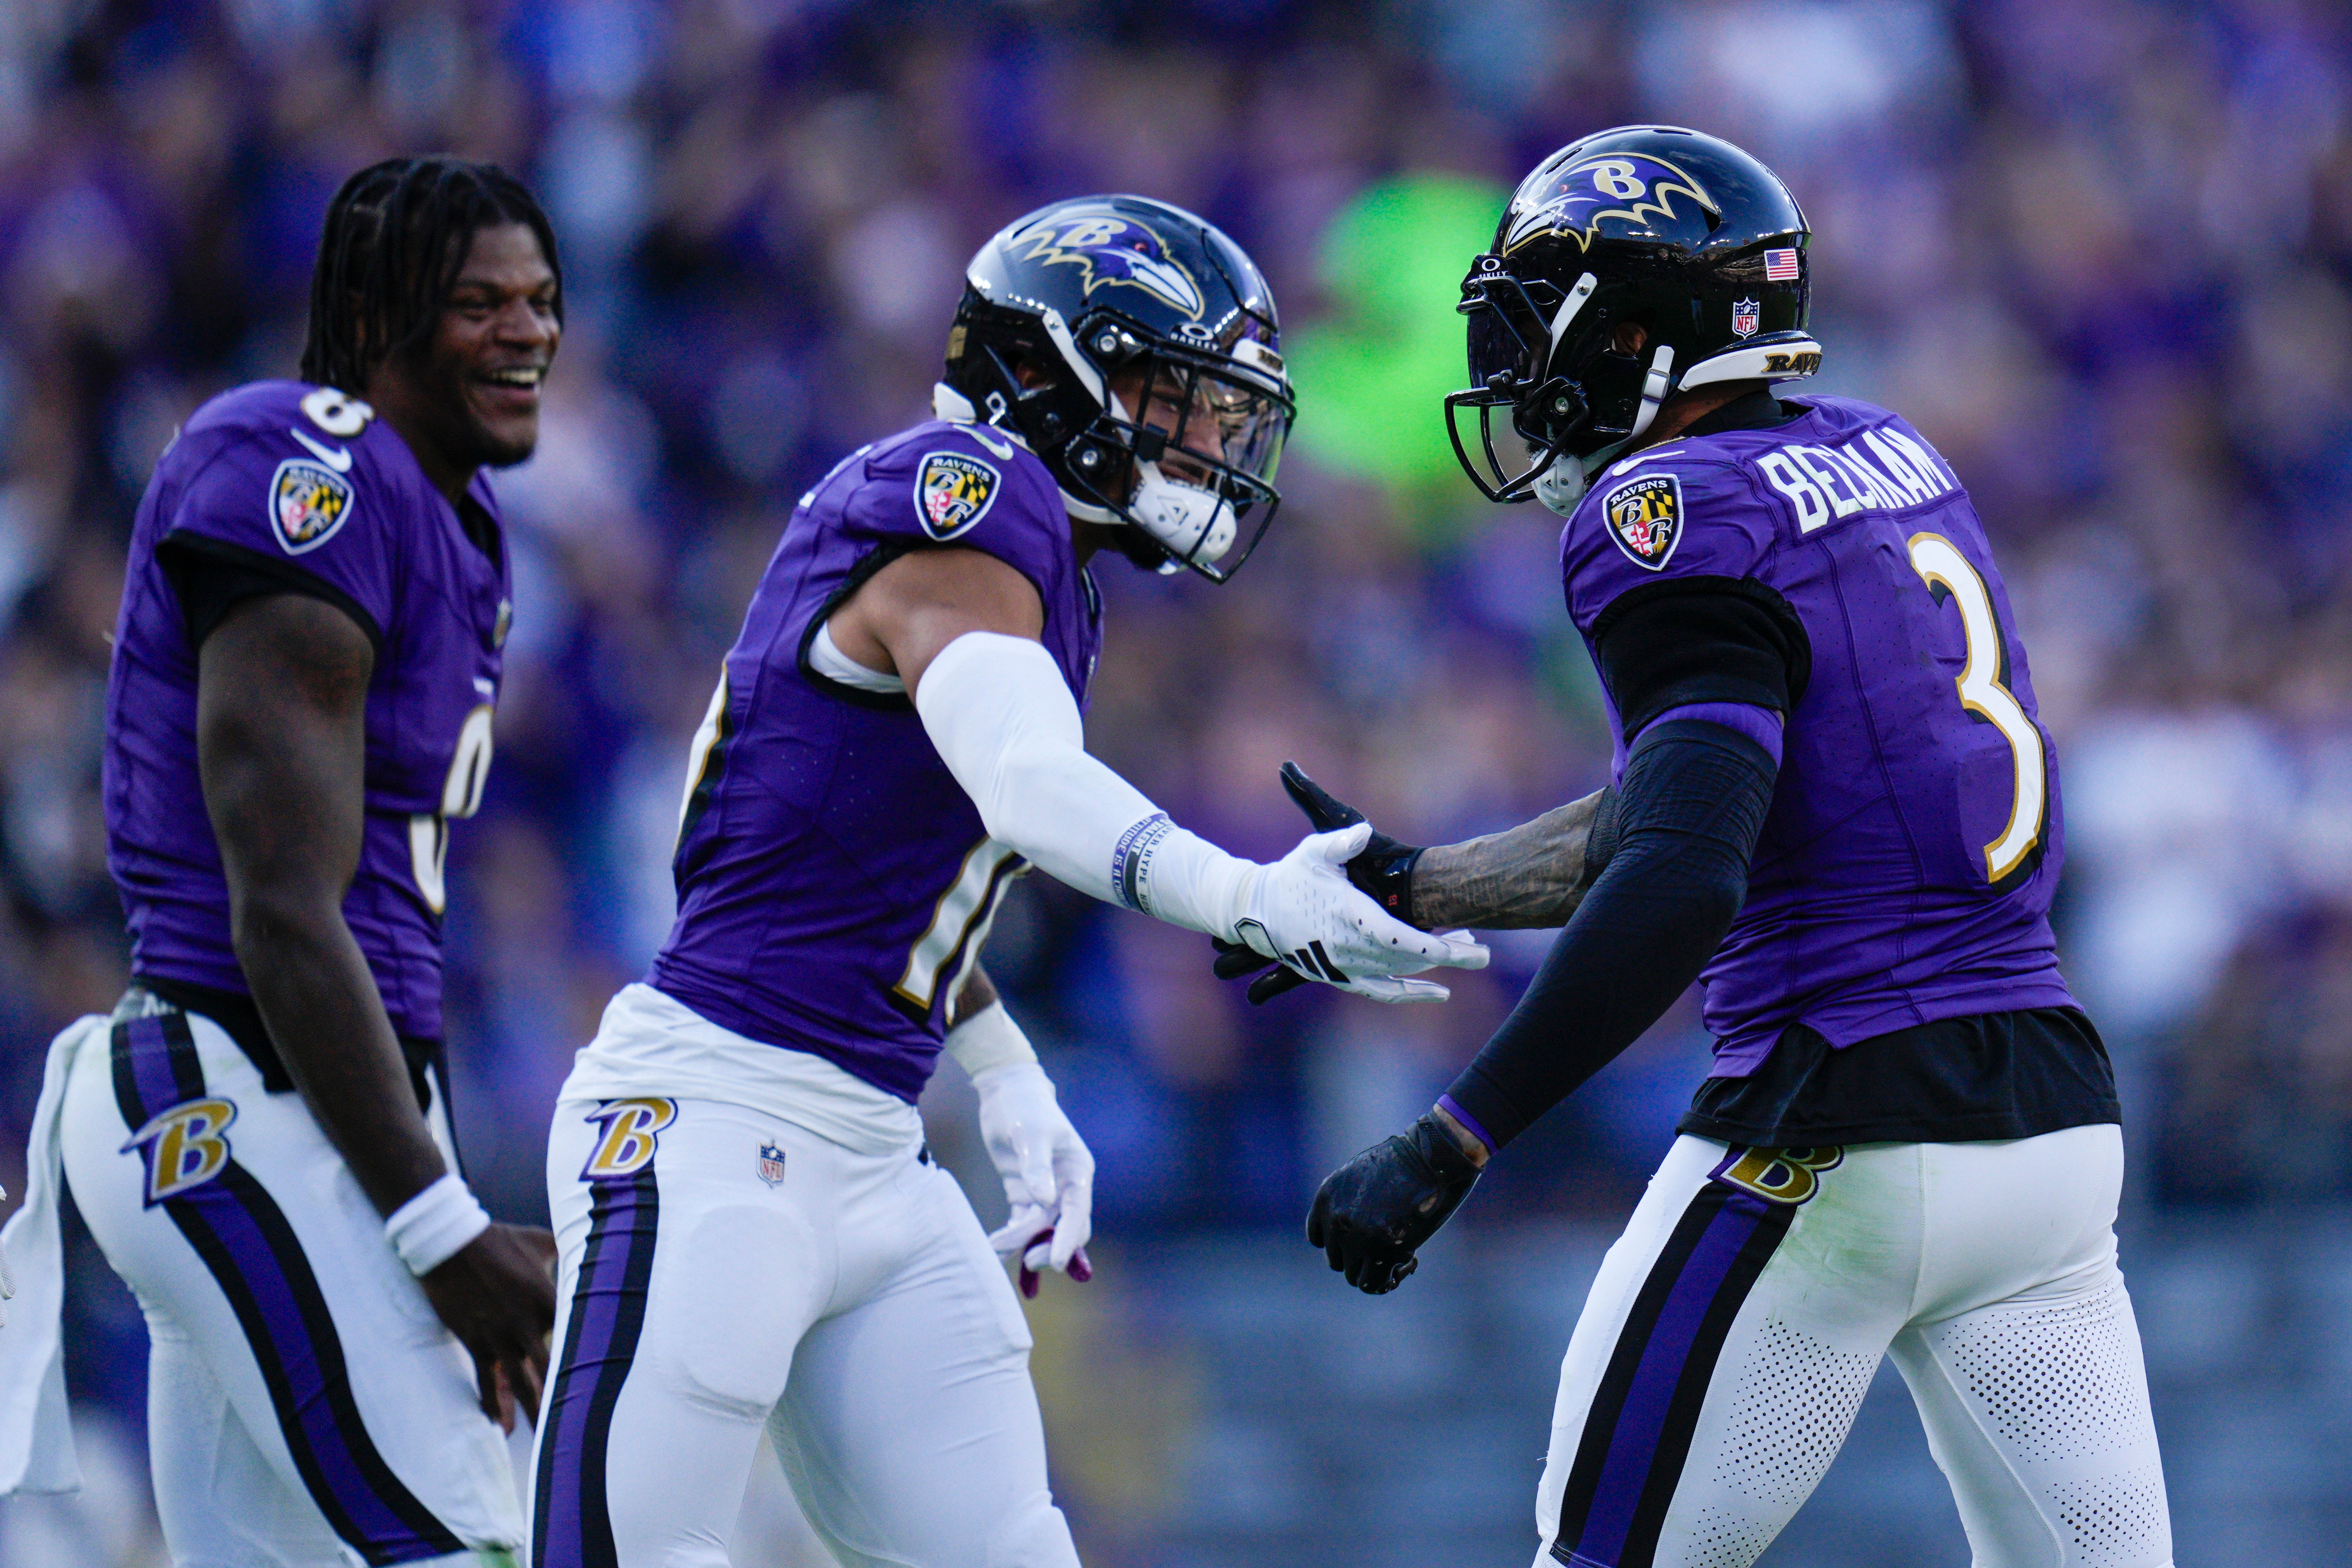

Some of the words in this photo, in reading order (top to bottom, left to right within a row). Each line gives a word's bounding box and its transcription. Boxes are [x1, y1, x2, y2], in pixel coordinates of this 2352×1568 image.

[1574, 160, 1646, 199] B
[1055, 218, 1127, 247] B
[1736, 316, 1755, 332] NFL
[932, 458, 990, 482] RAVENS
[1755, 427, 1953, 534] BECKHAM
[1610, 480, 1668, 506] RAVENS
[1613, 497, 1643, 527] B
[1646, 516, 1673, 546] R
[1908, 532, 2050, 893] 3
[1139, 849, 1153, 884] HYPE
[118, 1096, 238, 1212] B
[578, 1098, 678, 1182] B
